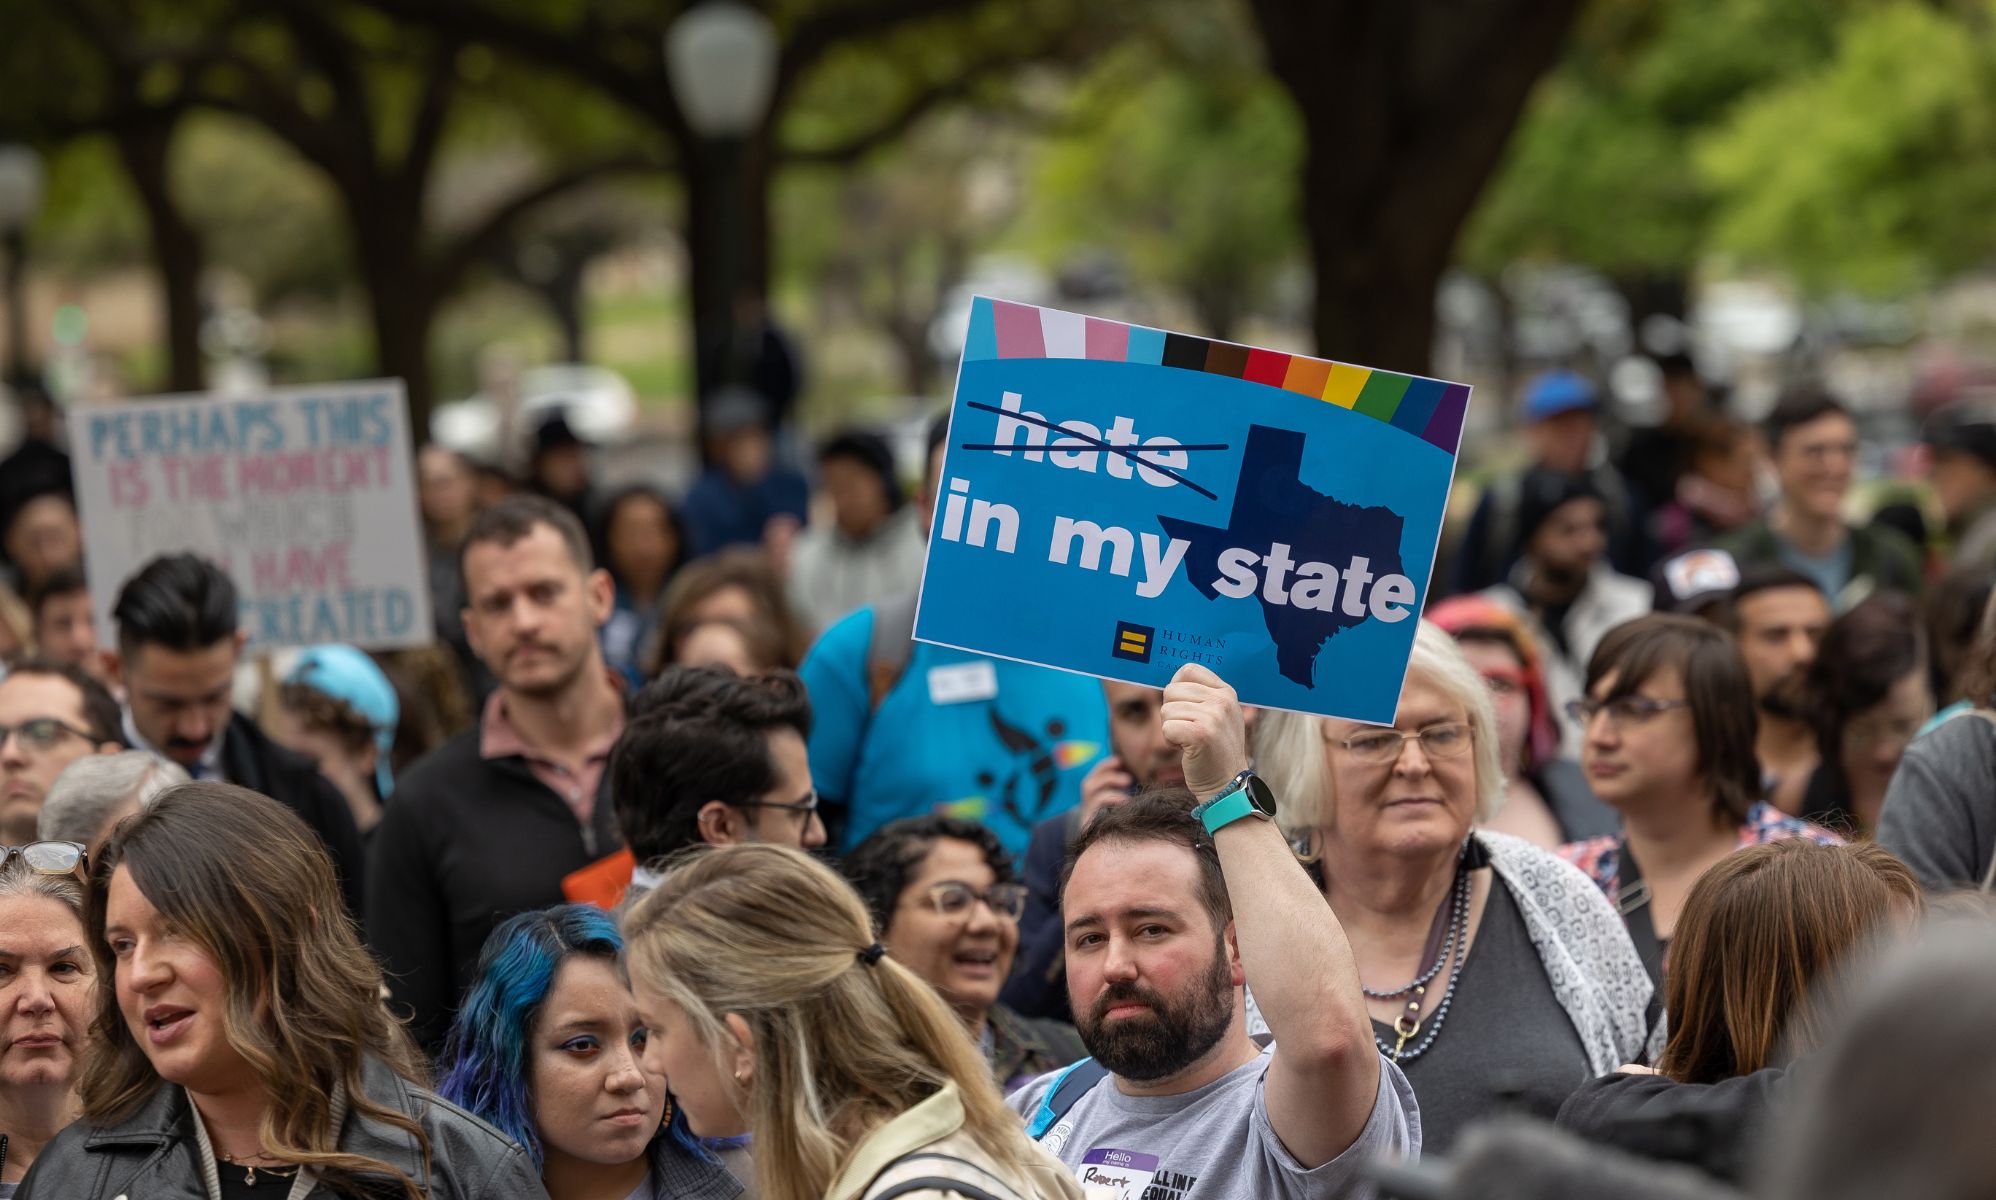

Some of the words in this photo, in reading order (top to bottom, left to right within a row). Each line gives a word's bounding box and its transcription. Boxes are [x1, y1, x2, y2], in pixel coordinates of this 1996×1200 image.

[89, 403, 284, 459] PERHAPS
[303, 394, 393, 446] THIS
[993, 391, 1188, 487] hate
[109, 460, 149, 508] IS
[162, 454, 226, 501] THE
[236, 445, 392, 496] MOMENT
[251, 540, 356, 593] HAVE
[941, 477, 1021, 554] in
[1048, 514, 1191, 598] my
[1211, 542, 1416, 623] state
[1160, 645, 1224, 666] RIGHTS
[1162, 629, 1227, 649] HUMAN
[1105, 1151, 1132, 1163] Hello
[1171, 1172, 1188, 1191] IN
